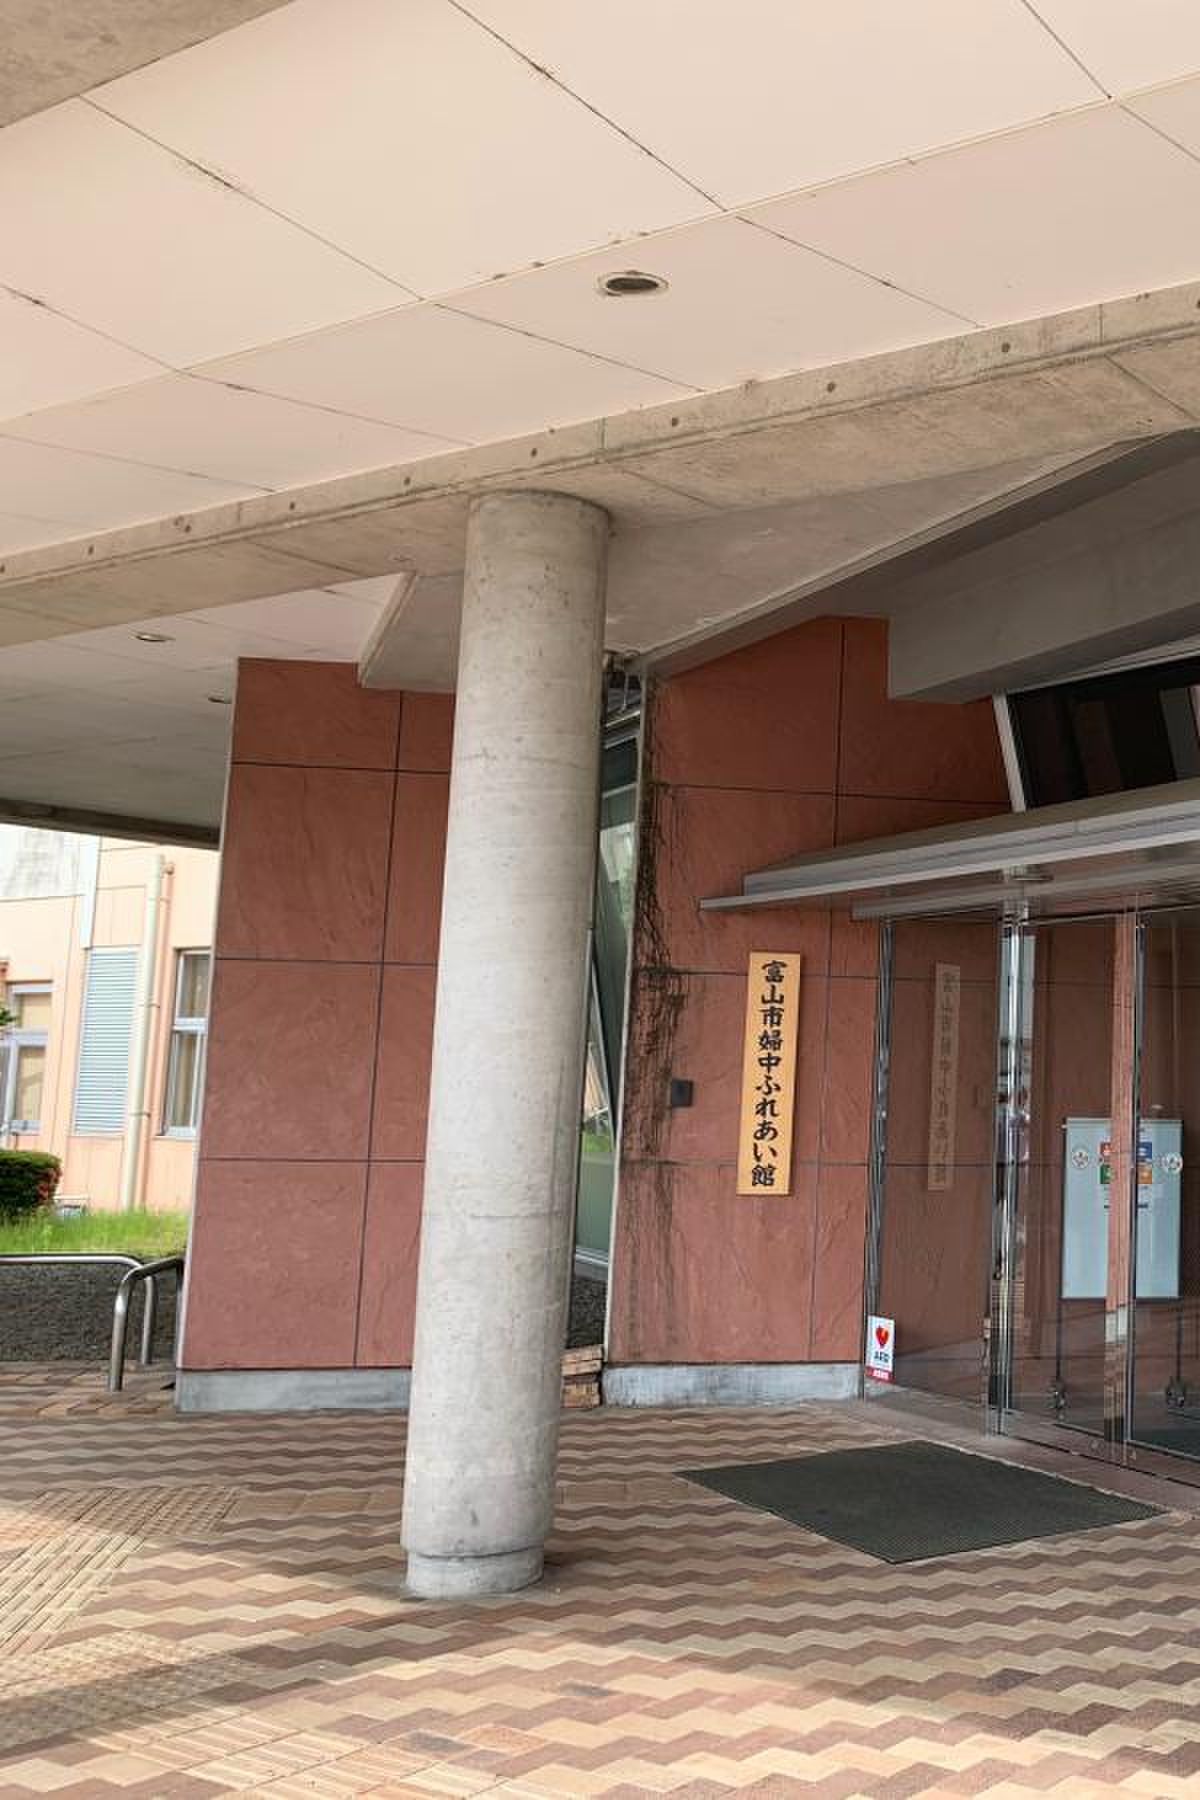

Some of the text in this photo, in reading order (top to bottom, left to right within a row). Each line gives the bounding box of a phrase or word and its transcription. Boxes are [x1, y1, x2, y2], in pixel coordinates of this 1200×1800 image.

[752, 960, 788, 1187] 富山市婦中ふれあい館
